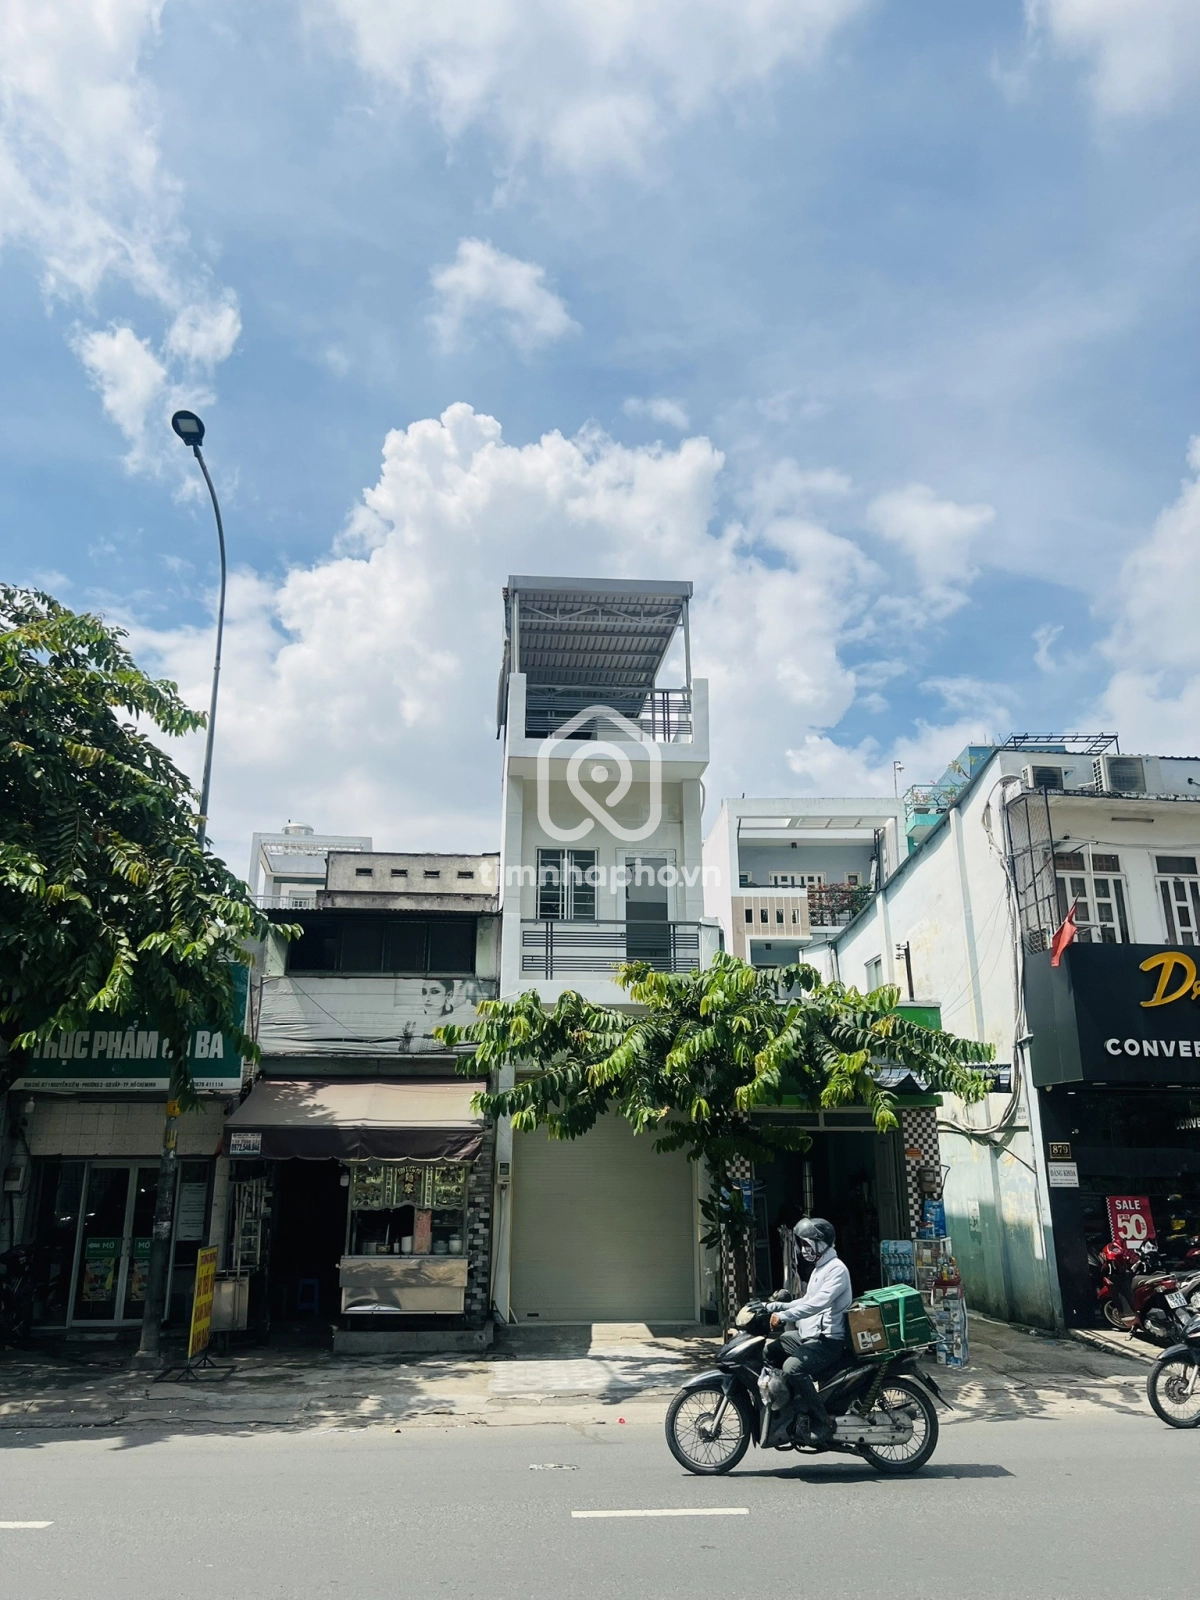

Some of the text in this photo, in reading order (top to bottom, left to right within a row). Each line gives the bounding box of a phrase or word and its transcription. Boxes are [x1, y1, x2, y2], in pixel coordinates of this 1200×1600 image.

[91, 1019, 159, 1059] PHẨM
[194, 1030, 224, 1059] BA
[1052, 1145, 1068, 1154] 879
[1115, 1199, 1141, 1210] SALE
[1117, 1213, 1148, 1240] 50
